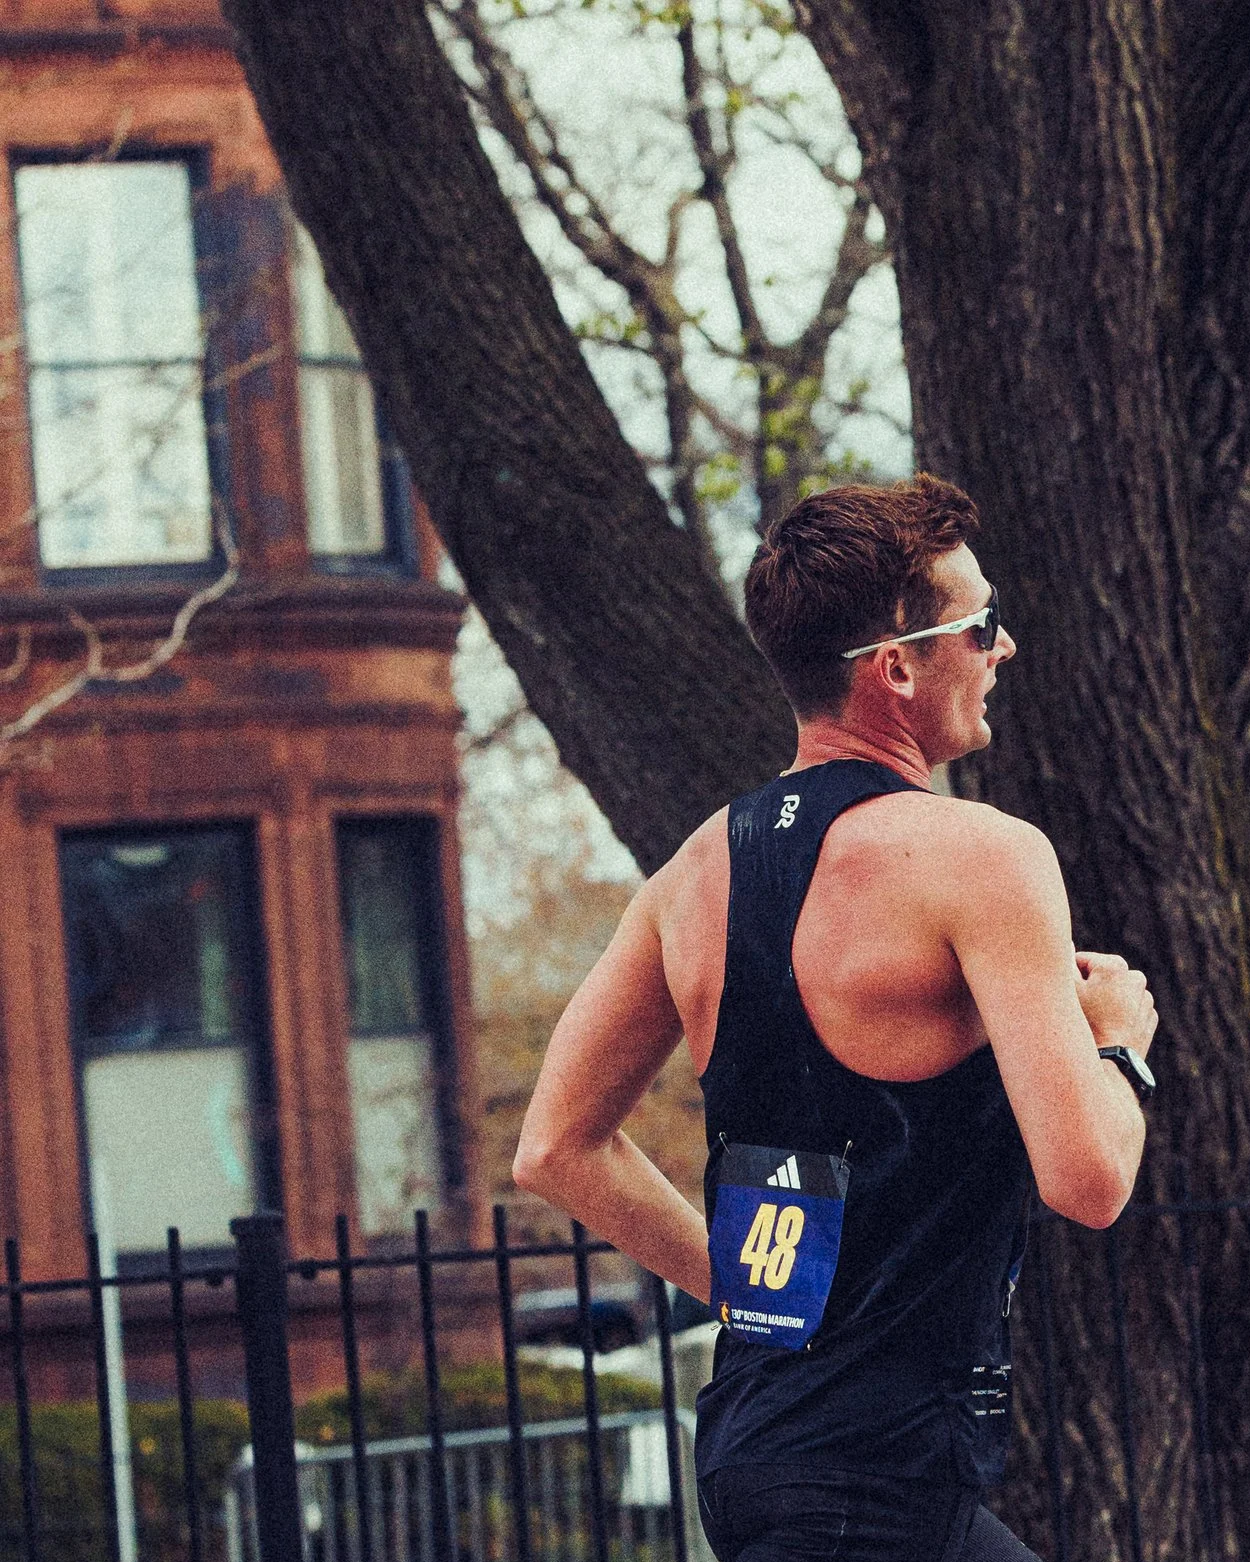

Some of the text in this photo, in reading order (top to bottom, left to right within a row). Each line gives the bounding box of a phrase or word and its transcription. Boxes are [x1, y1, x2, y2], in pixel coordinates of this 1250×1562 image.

[740, 1203, 804, 1290] 48
[743, 1310, 767, 1325] BOSTON
[768, 1313, 805, 1329] MARATHON
[751, 1325, 772, 1334] AMERICA
